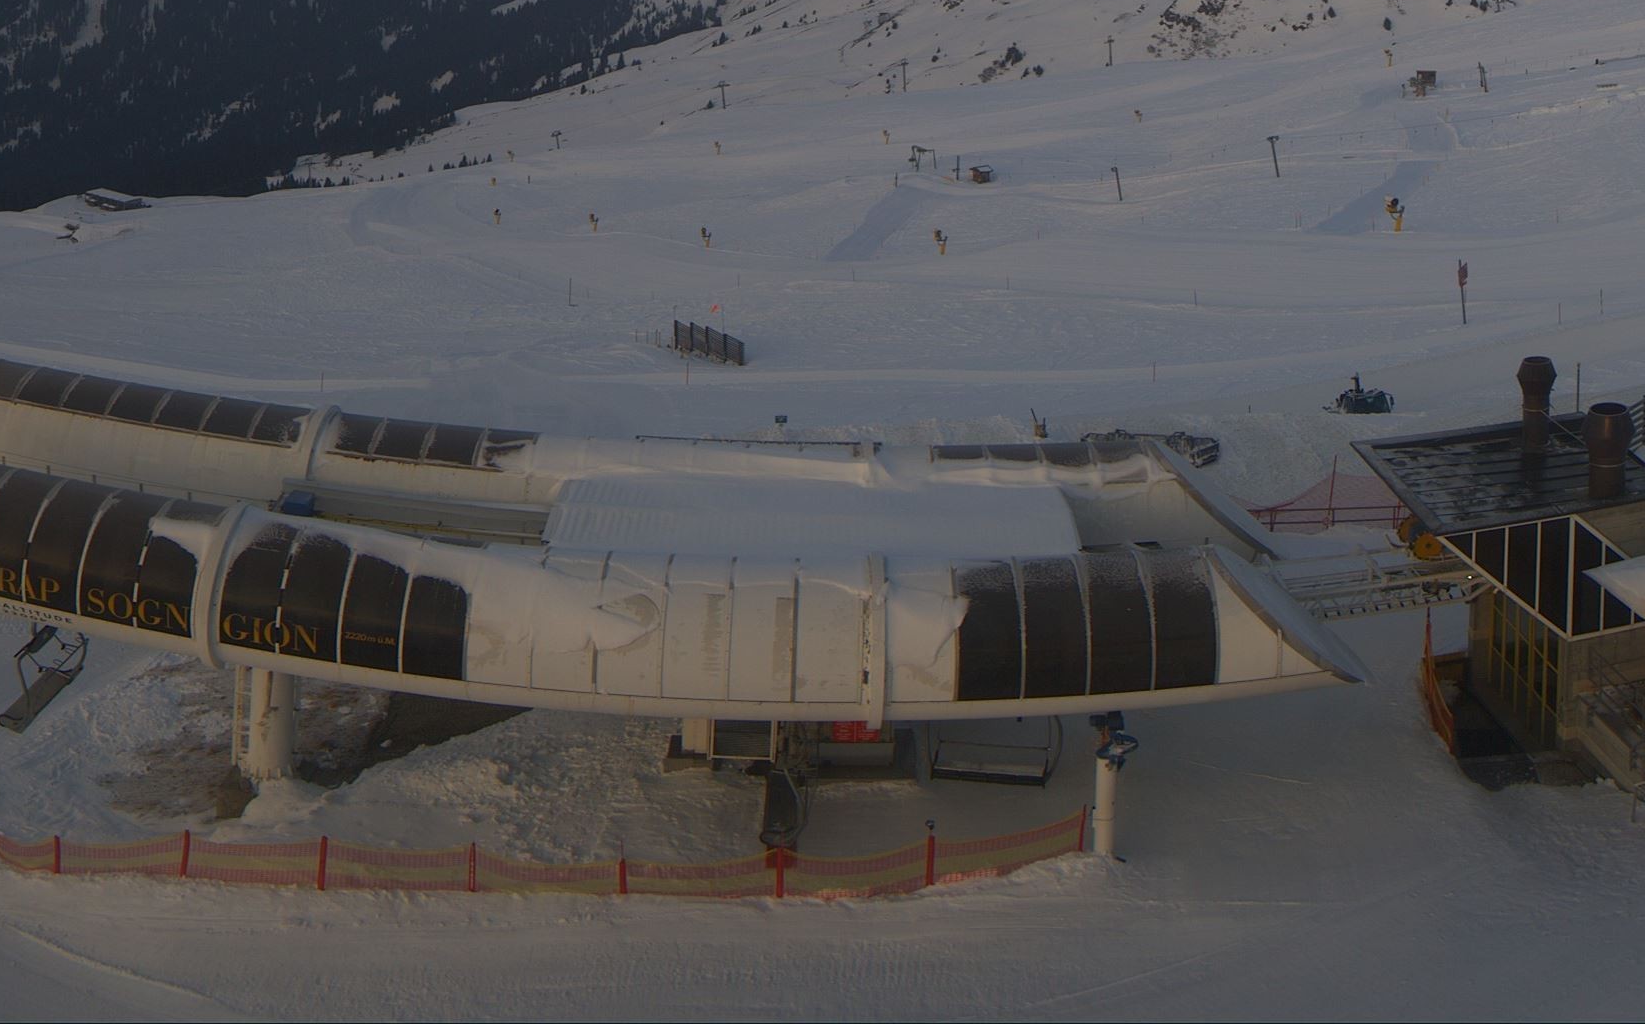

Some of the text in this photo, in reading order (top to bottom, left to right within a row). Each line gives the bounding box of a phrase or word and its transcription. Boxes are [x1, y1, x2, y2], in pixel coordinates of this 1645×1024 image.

[3, 603, 72, 623] ALTITUDE
[87, 588, 189, 631] SOGN
[223, 613, 319, 654] GION
